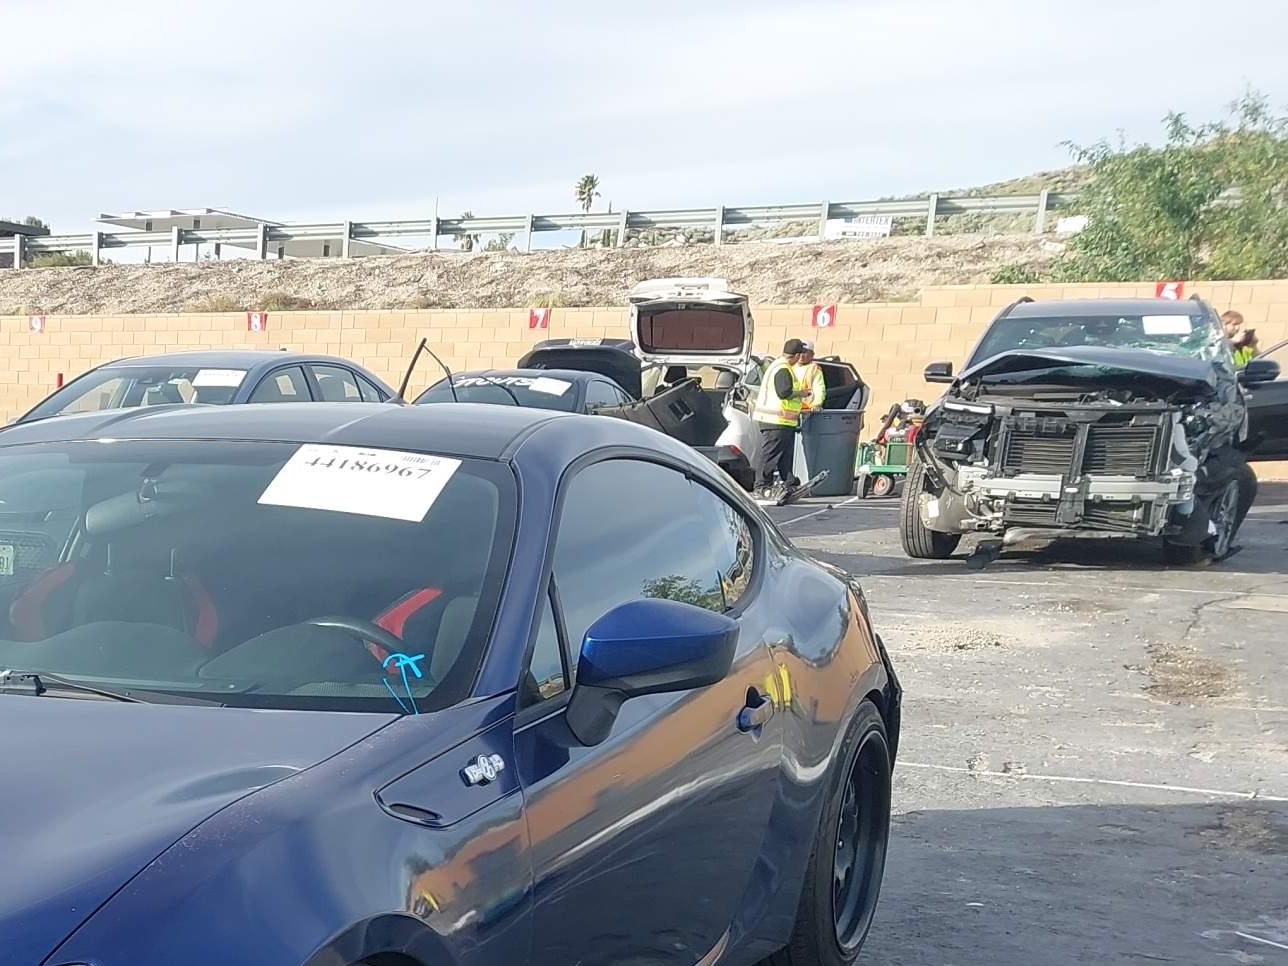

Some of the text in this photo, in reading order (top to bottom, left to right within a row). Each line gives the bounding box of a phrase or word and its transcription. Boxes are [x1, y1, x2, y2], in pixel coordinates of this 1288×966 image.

[250, 311, 261, 332] 8
[533, 307, 547, 329] 7
[816, 303, 831, 328] 6
[304, 456, 432, 479] 44186967
